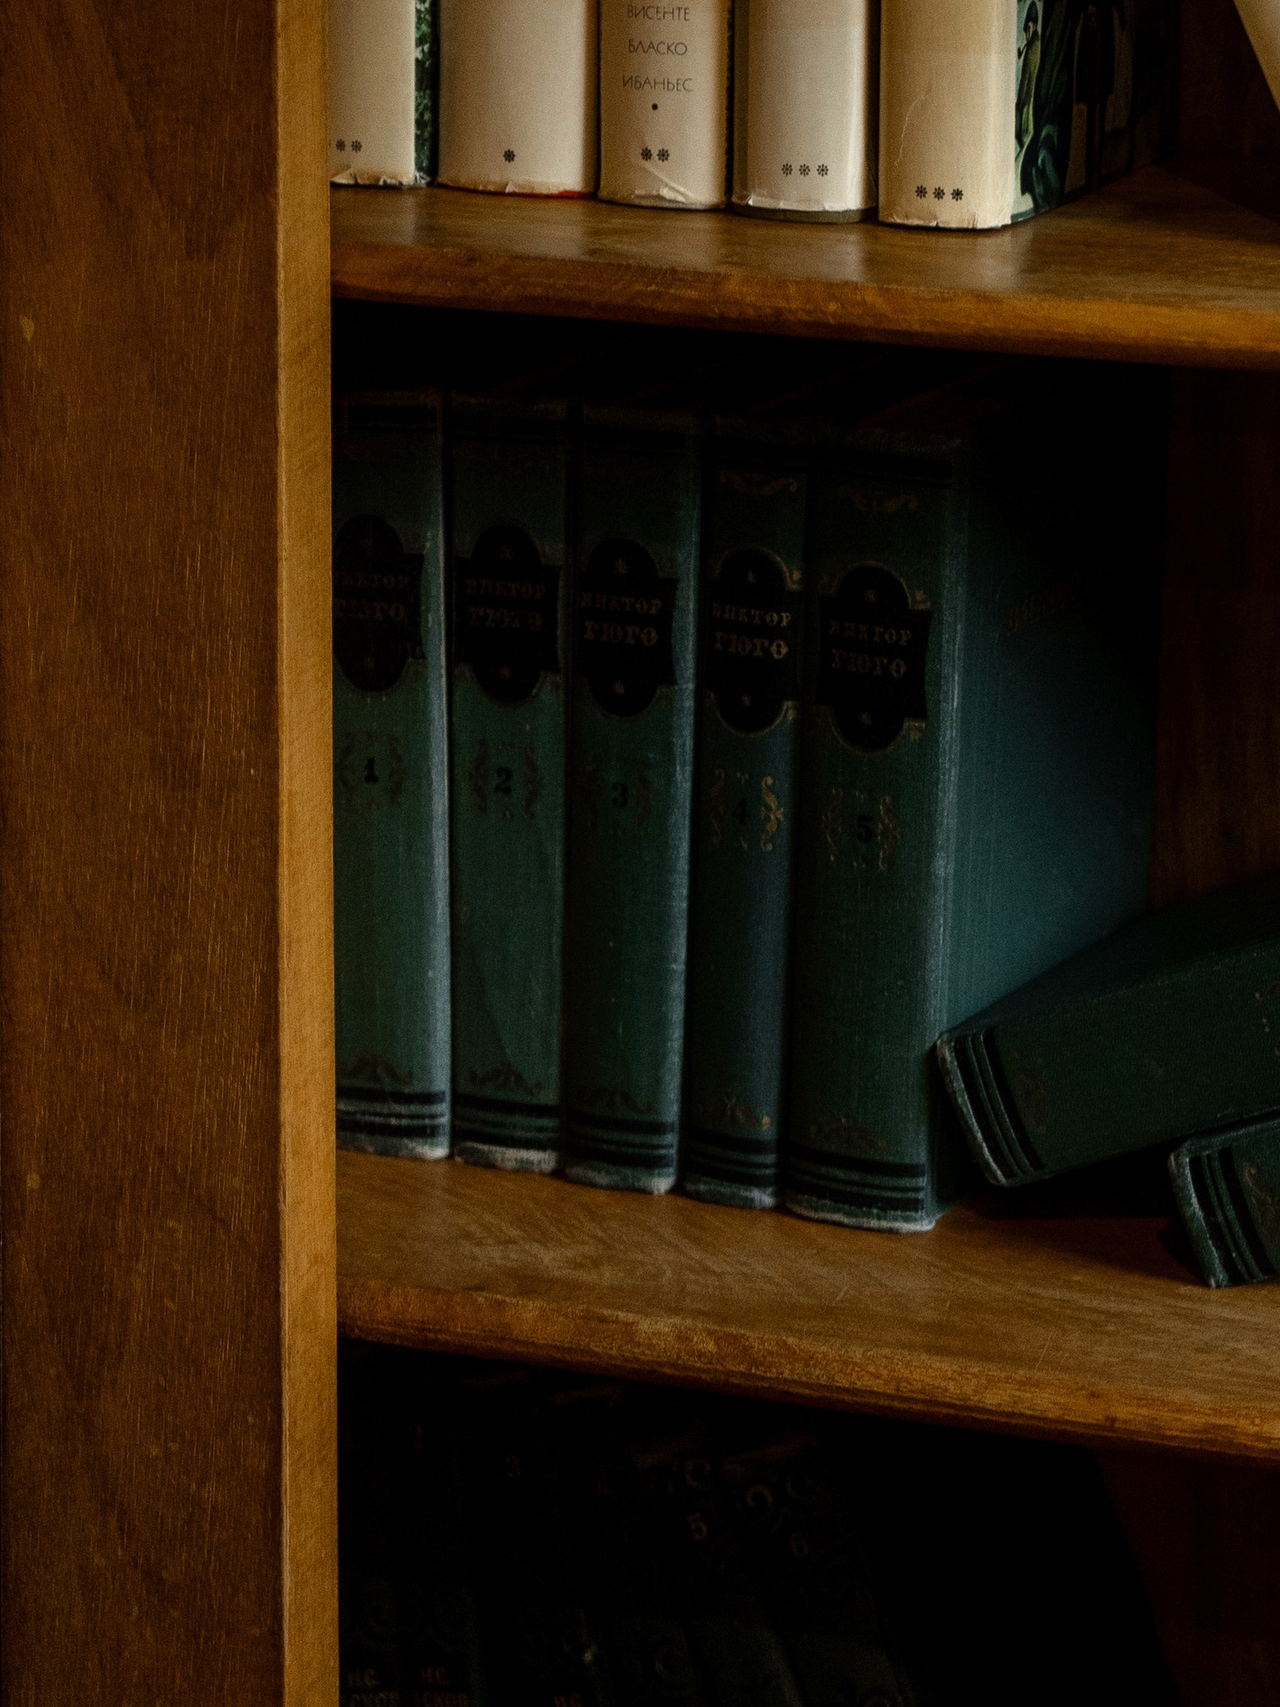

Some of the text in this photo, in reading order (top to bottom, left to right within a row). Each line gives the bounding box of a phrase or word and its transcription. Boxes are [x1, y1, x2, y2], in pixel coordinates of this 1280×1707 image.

[626, 4, 691, 22] ВИСЕНТЕ
[627, 38, 688, 56] БЛАСКО
[622, 73, 694, 93] ИБАНЬЕС
[463, 576, 547, 601] ВИКТОР
[579, 590, 664, 616] ВИКТОР
[711, 602, 792, 628] ВИКТОР
[468, 605, 544, 634] ГЮГО
[583, 619, 660, 647] ГЮГО
[827, 617, 913, 646] ВИКТОР
[713, 631, 790, 661] ГЮГО
[831, 647, 908, 679] ГЮГО
[363, 756, 380, 785] 1
[493, 766, 513, 795] 2
[611, 781, 628, 809] 3
[732, 797, 749, 826] 4
[855, 814, 874, 844] 5
[686, 1510, 709, 1542] 5
[788, 1531, 810, 1559] 6
